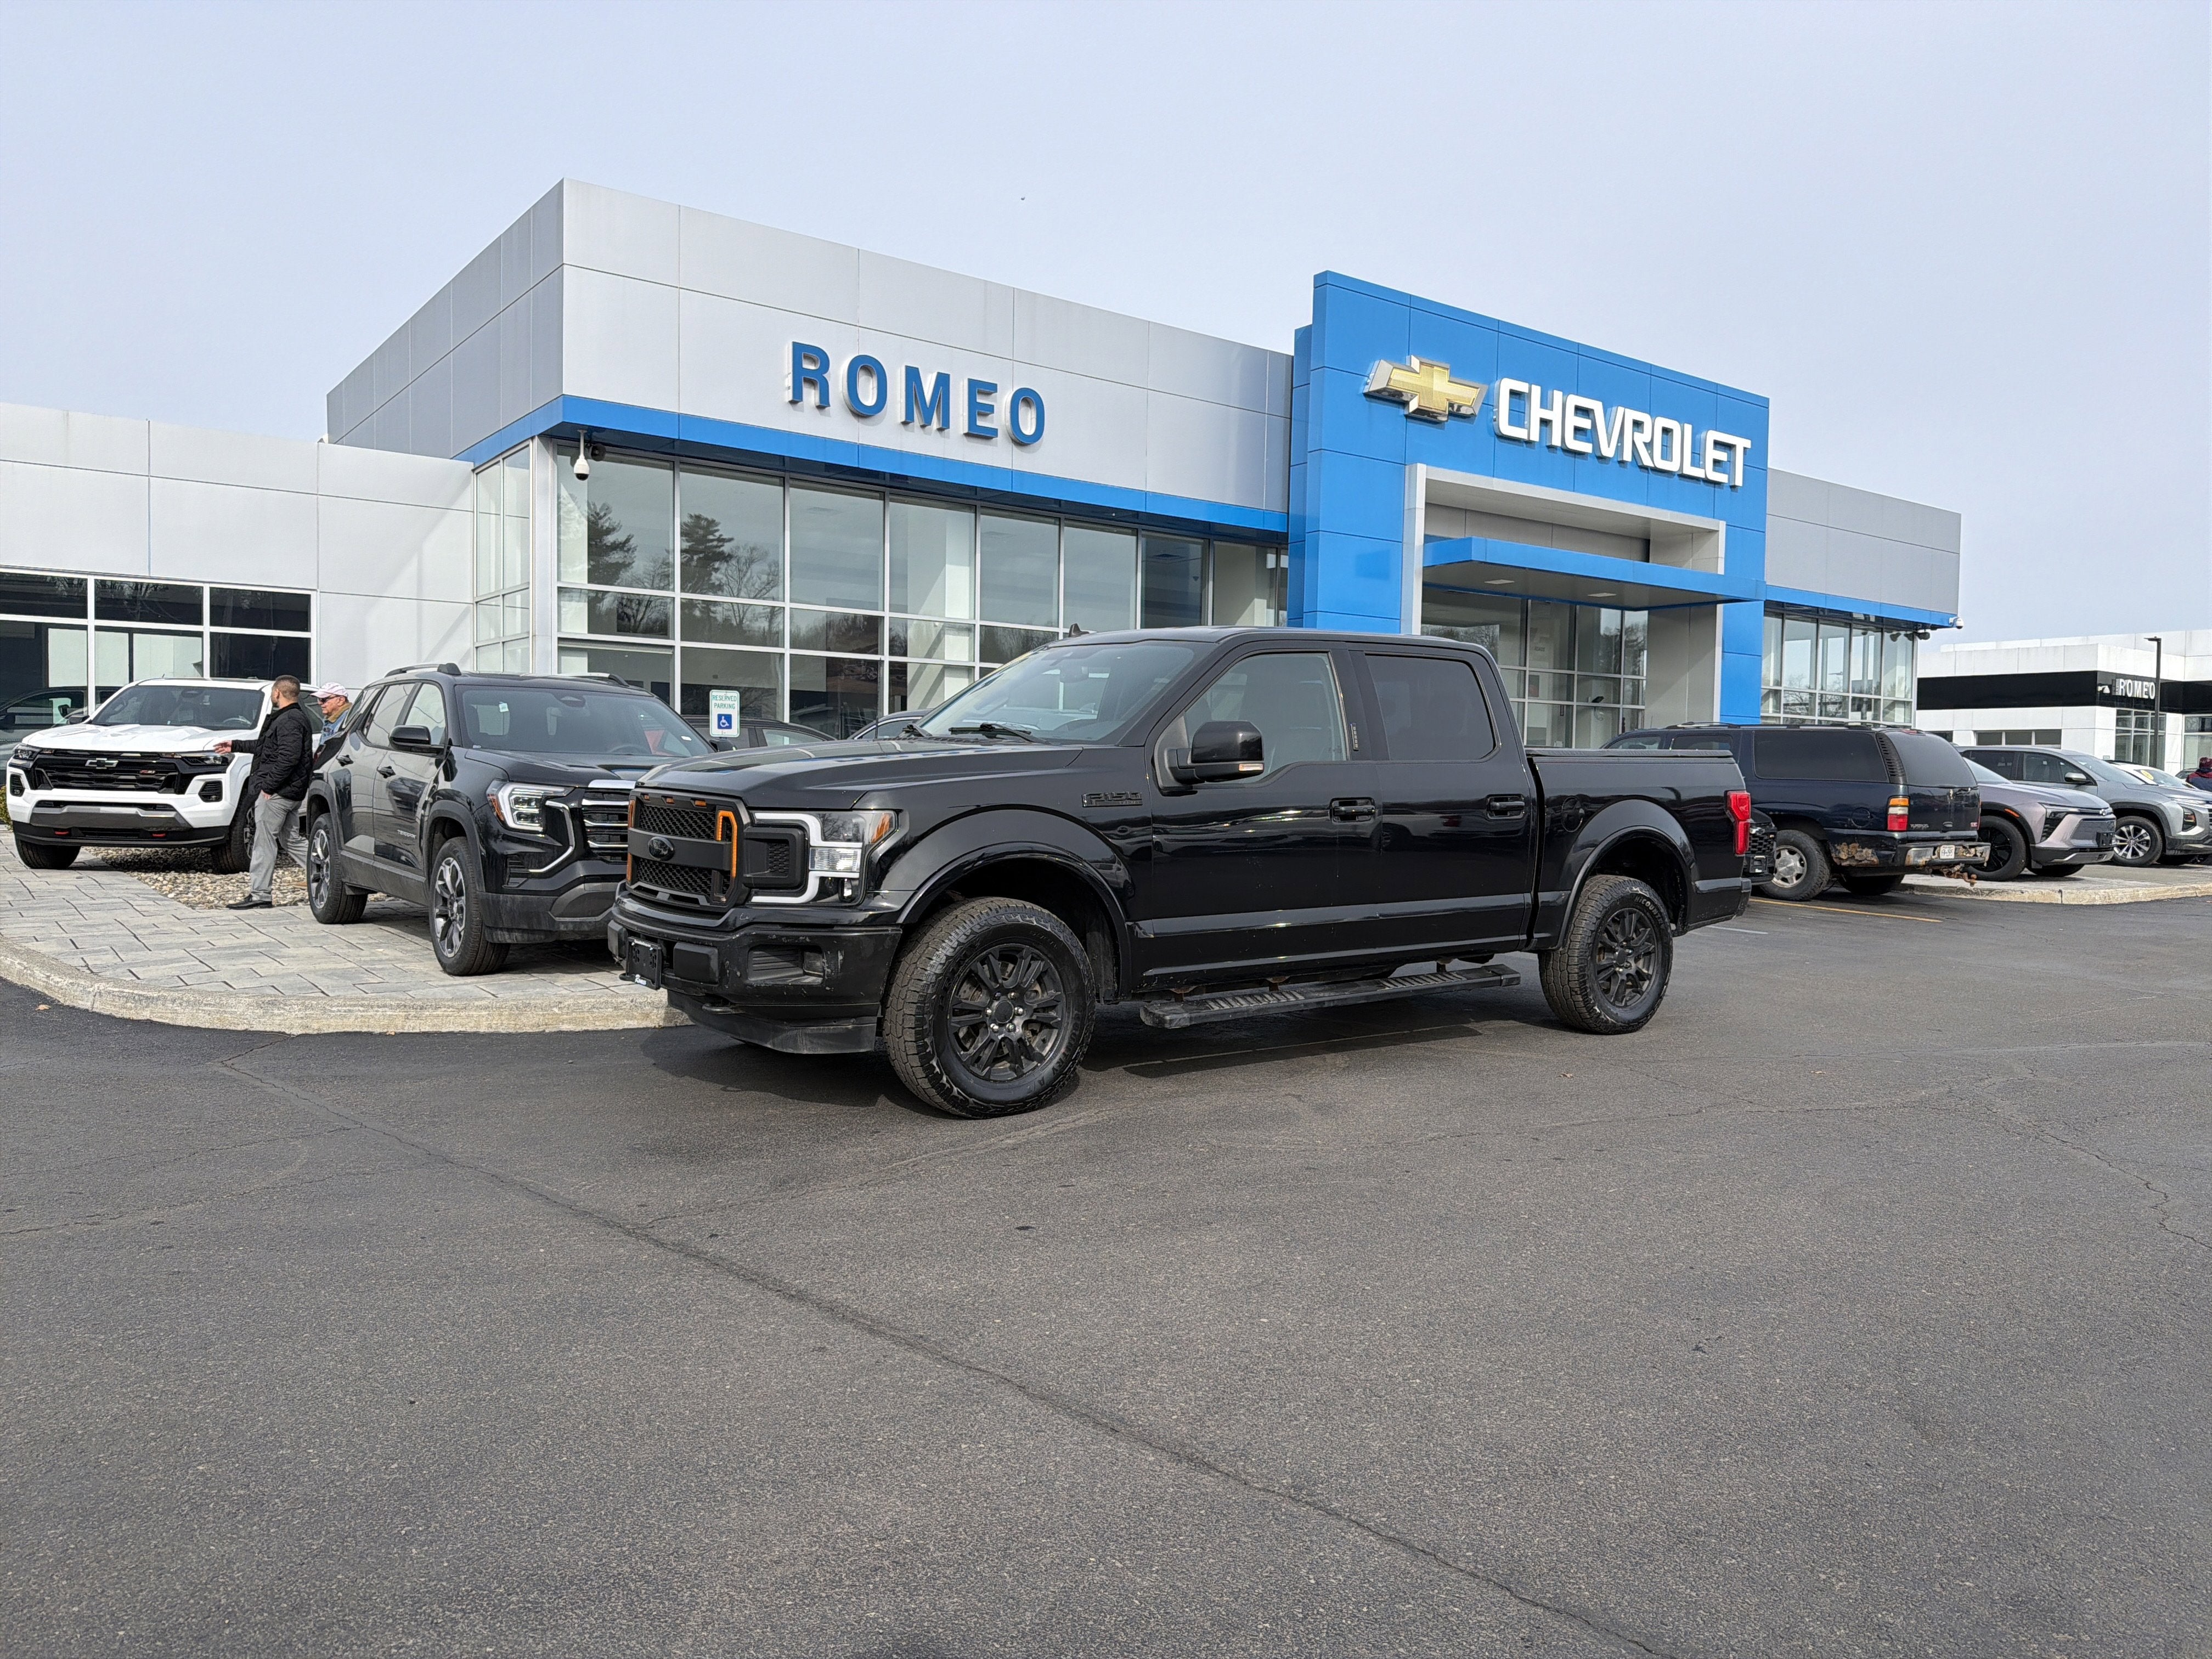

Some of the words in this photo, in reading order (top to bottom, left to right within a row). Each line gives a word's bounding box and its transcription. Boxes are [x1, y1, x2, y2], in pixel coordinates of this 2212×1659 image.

[788, 341, 1045, 445] ROMEO
[1496, 377, 1752, 487] CHEVROLET
[2116, 678, 2155, 699] ROMEO
